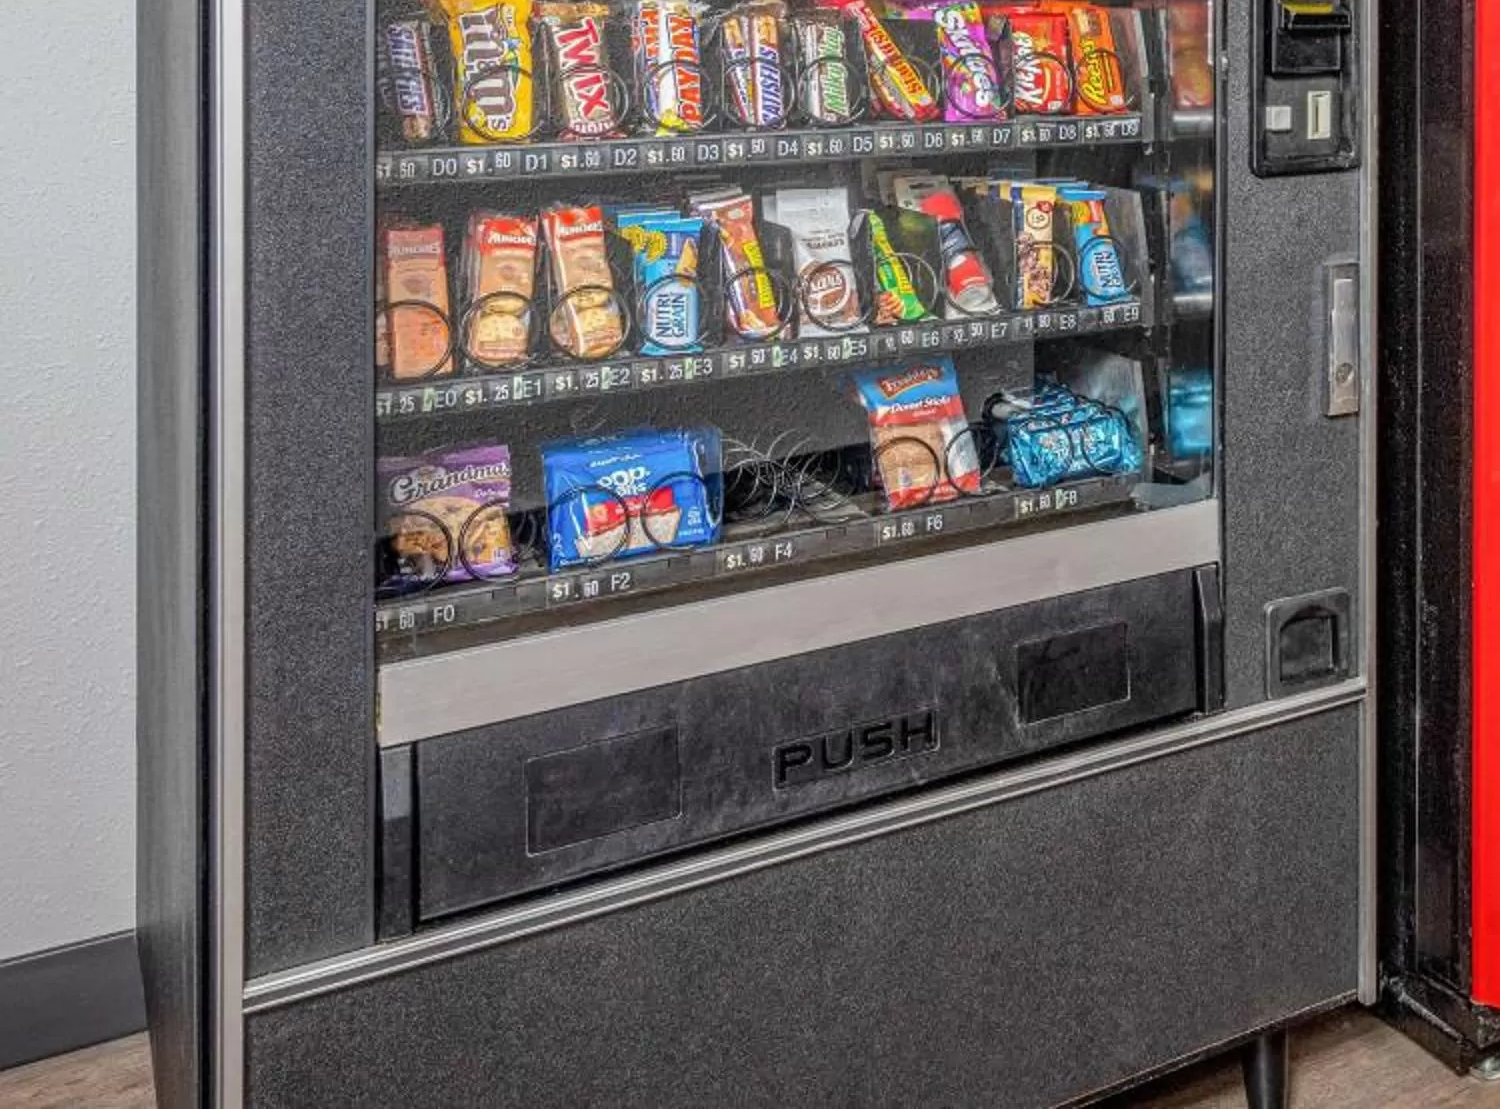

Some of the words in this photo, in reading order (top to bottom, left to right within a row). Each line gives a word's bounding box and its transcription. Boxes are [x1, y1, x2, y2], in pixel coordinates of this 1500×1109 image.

[554, 15, 611, 119] TWIX
[933, 9, 994, 108] Skittles
[853, 135, 873, 152] D5
[925, 132, 943, 149] D6
[992, 128, 1011, 144] D7
[615, 148, 638, 166] D2
[697, 144, 719, 161] D3
[777, 140, 799, 156] D4
[432, 158, 457, 177] D0
[525, 154, 548, 170] D1
[655, 292, 671, 339] NUTRI
[670, 292, 686, 339] GRAIN
[1059, 315, 1077, 332] E8
[1123, 307, 1140, 322] E9
[991, 322, 1008, 339] E7
[849, 341, 867, 357] E5
[921, 332, 940, 348] E6
[781, 348, 799, 365] E4
[640, 363, 684, 382] $1.25
[693, 358, 714, 376] E3
[555, 372, 600, 392] $1.25
[611, 367, 631, 385] E2
[436, 388, 458, 407] E0
[464, 384, 509, 405] $1.25
[522, 379, 542, 398] E1
[926, 514, 944, 532] F6
[775, 542, 793, 561] F4
[610, 571, 632, 592] F2
[433, 604, 456, 624] F0
[776, 711, 937, 784] PUSH
